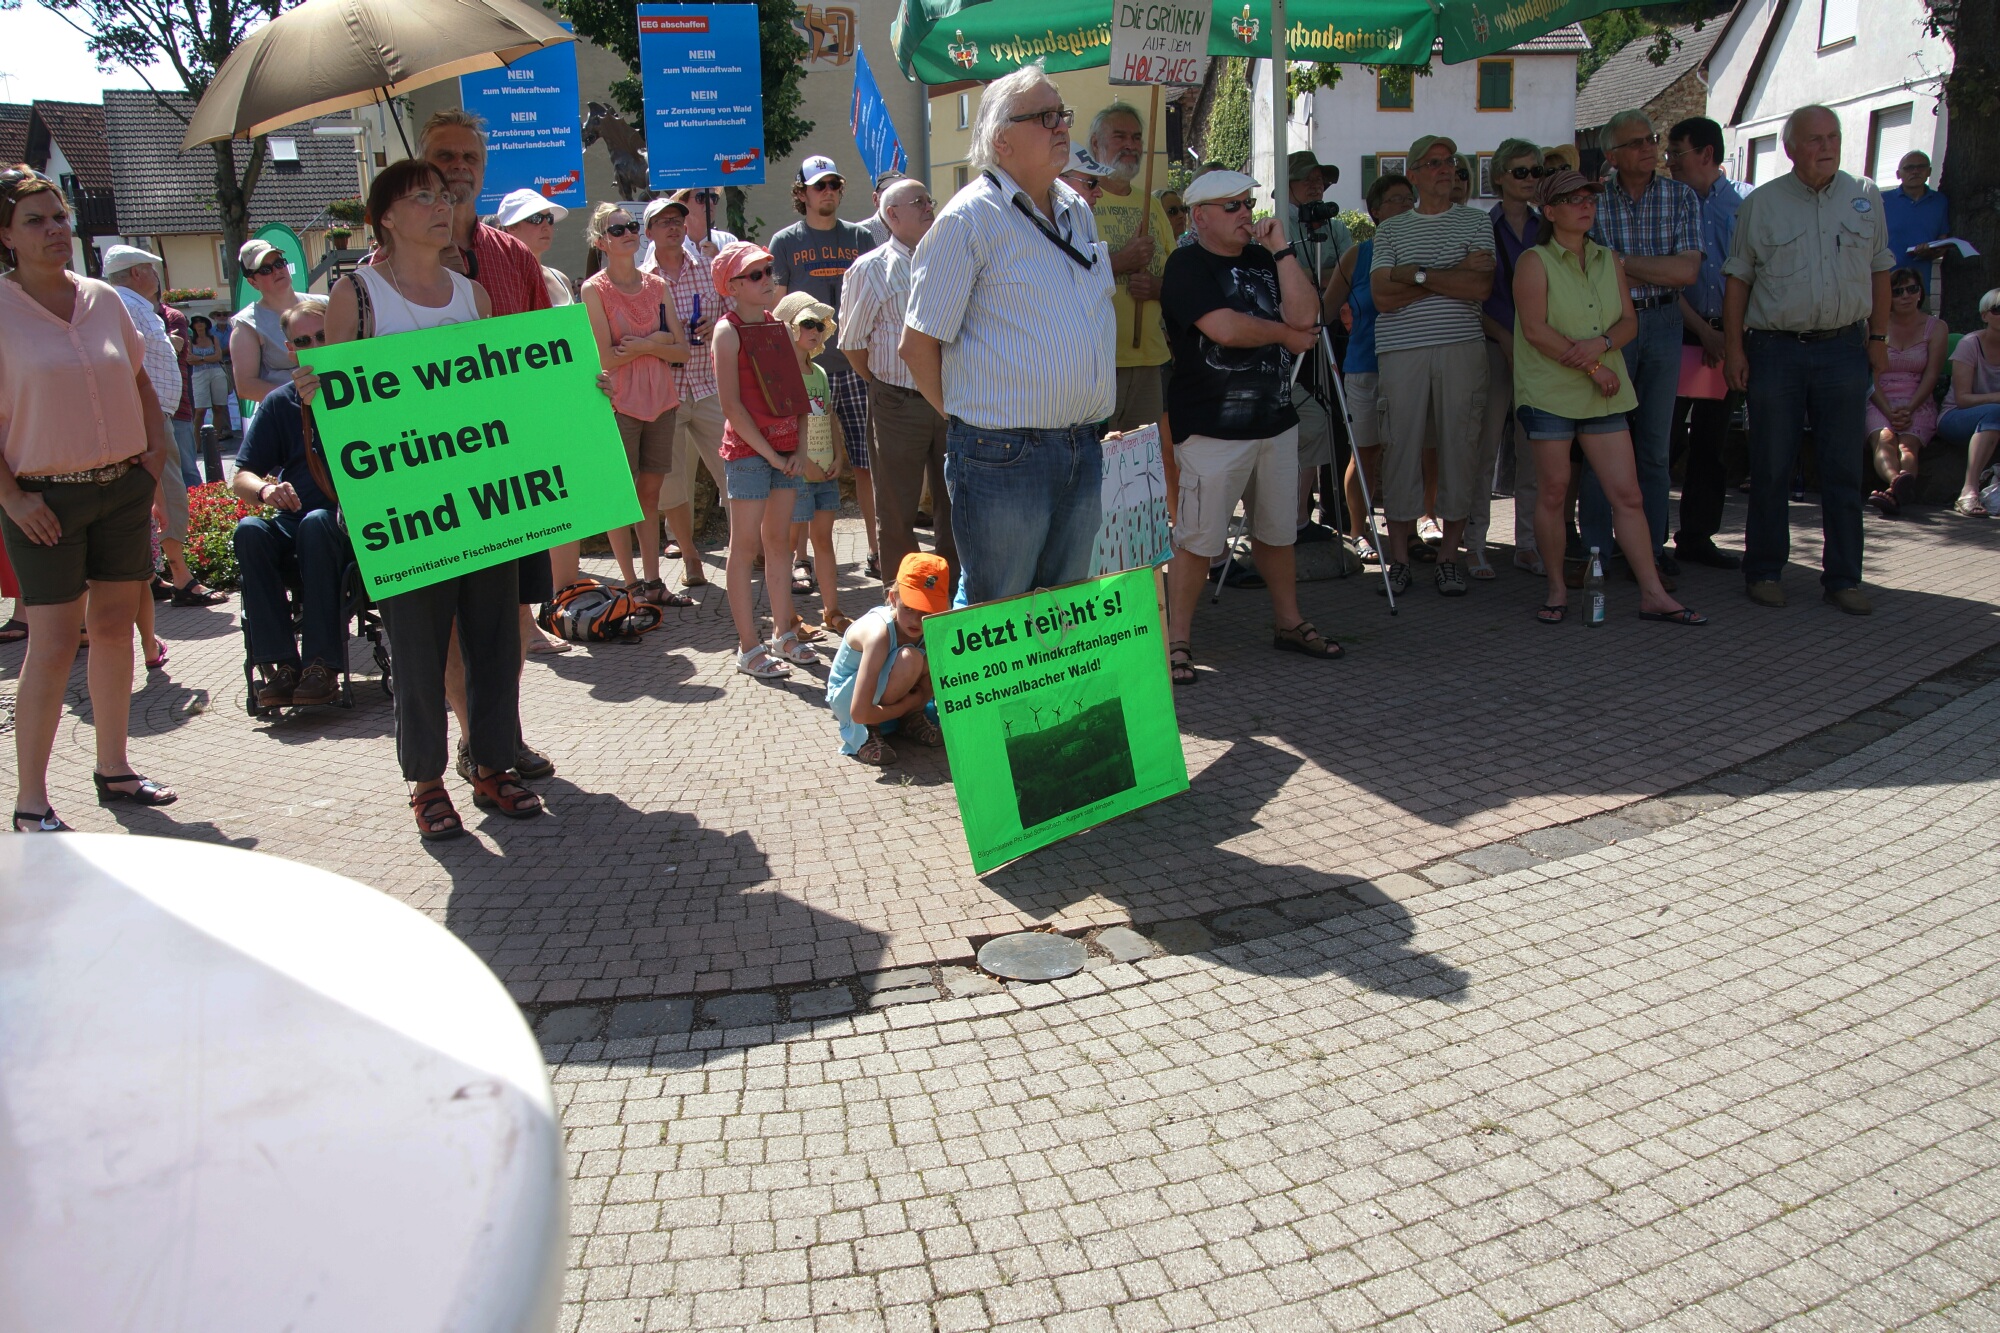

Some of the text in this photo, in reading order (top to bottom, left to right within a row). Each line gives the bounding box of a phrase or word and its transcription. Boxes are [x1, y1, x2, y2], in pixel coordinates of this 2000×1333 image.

[661, 20, 705, 28] abschaffen
[1145, 4, 1205, 35] GRÜNEN
[1142, 37, 1191, 53] AUF DEM
[689, 50, 716, 60] NEIN
[682, 65, 742, 73] Windkraftwahn
[1122, 53, 1197, 82] HOLZWEG
[507, 70, 535, 80] NEIN
[482, 86, 560, 95] zum Windkraftwahn
[691, 90, 718, 100] NEIN
[671, 107, 716, 115] Zerstörung
[733, 105, 752, 113] Wald
[511, 112, 537, 122] NEIN
[663, 118, 746, 128] und Kulturlandschaft
[492, 128, 535, 138] Zerstörung
[552, 127, 571, 135] Wald
[502, 139, 566, 150] Kulturlandschaft
[714, 152, 755, 161] Alternative
[534, 174, 576, 185] Alternative
[793, 248, 816, 266] PRO
[317, 337, 573, 411] Die wahren
[340, 419, 510, 480] Grünen
[361, 464, 569, 552] sind WIR!
[374, 520, 572, 586] Bürgerinitiative Fischbacher Horizonte
[951, 617, 1018, 656] Jetzt
[939, 623, 1149, 690] Keine 200 m Windkraftanlagen im
[944, 658, 1102, 714] Bad Schwalbacher Wald!
